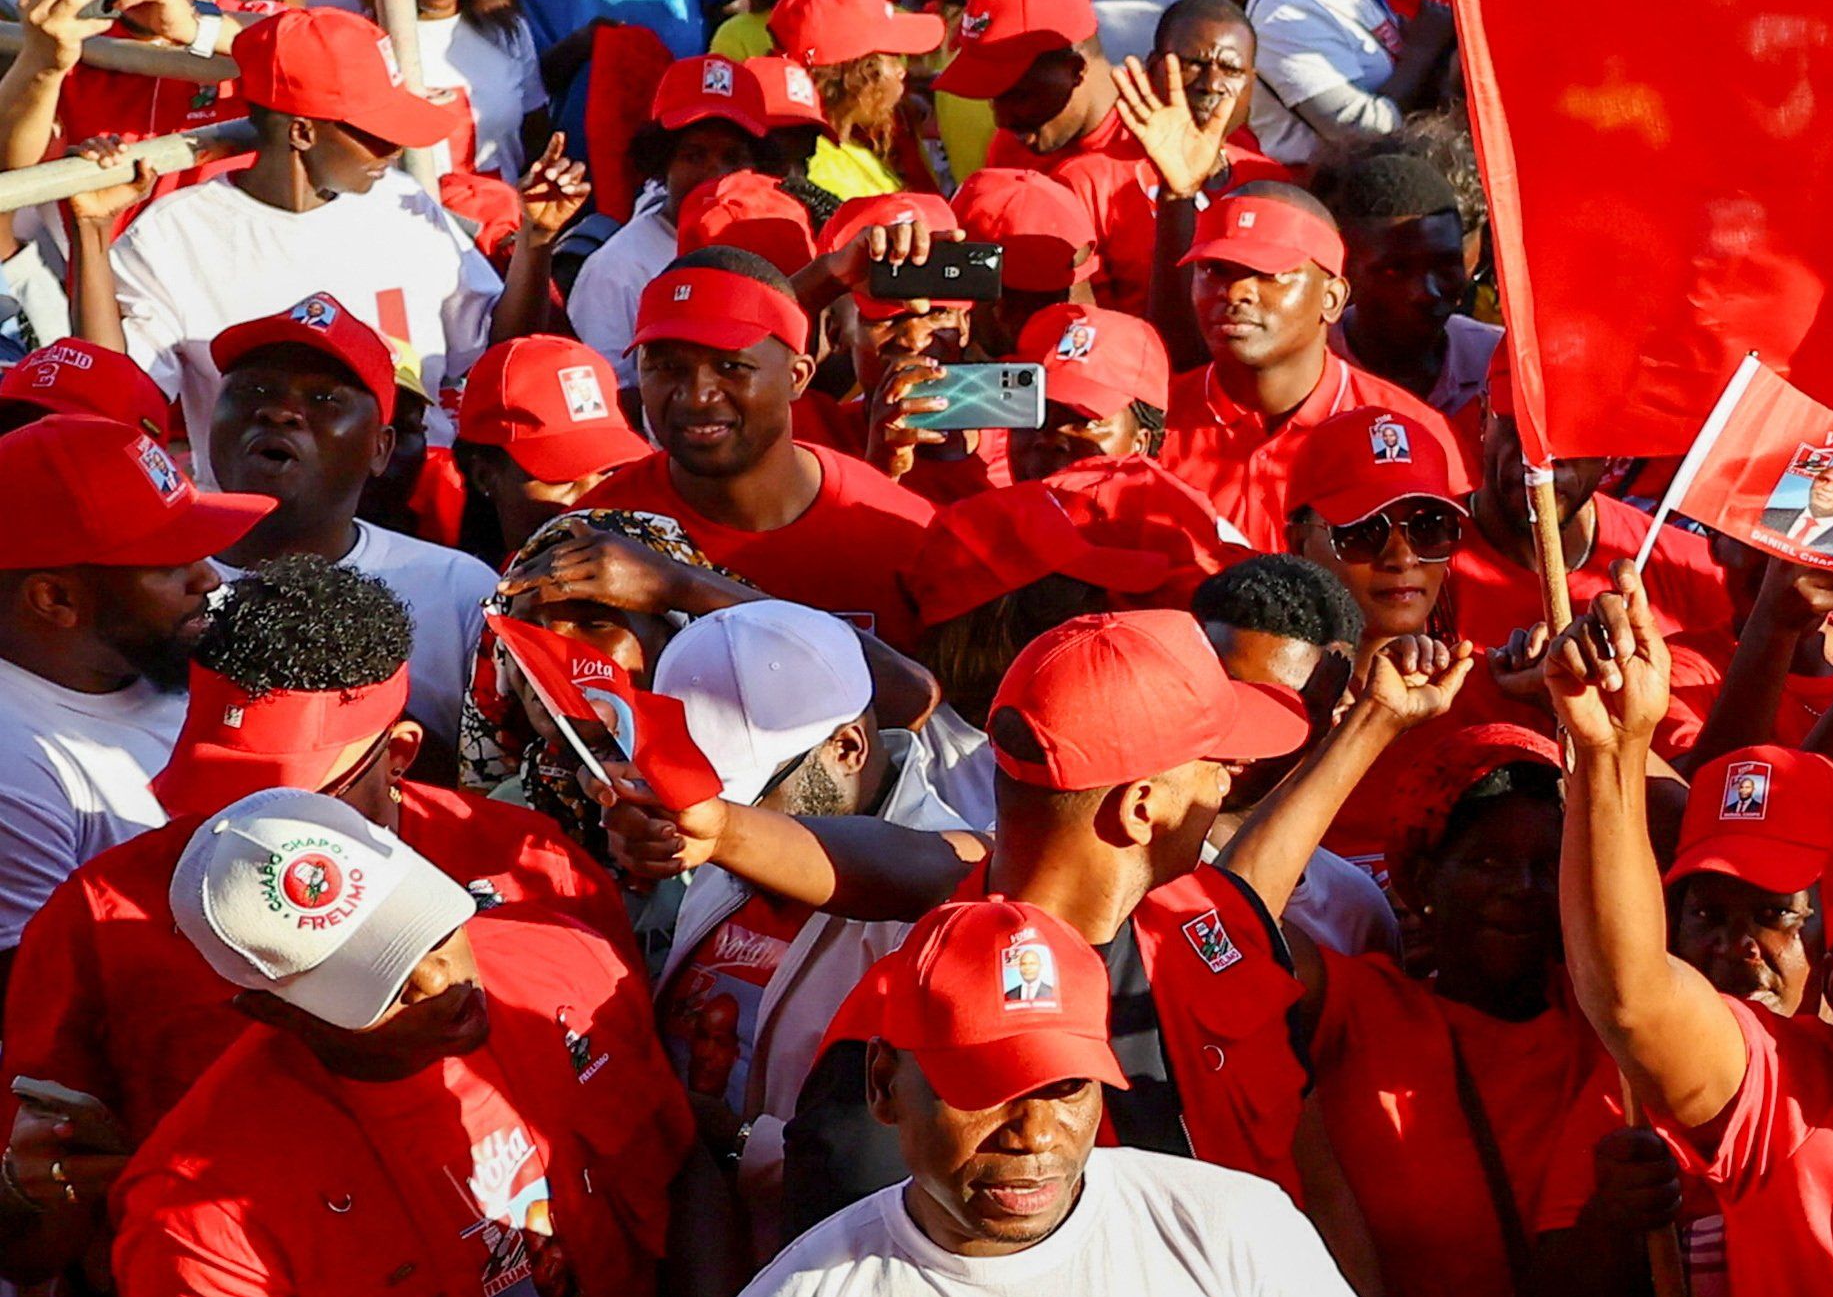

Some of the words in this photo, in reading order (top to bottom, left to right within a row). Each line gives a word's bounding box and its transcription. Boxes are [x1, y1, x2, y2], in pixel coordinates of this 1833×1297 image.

[1750, 530, 1796, 557] DANIEL
[572, 657, 614, 678] Vota
[281, 837, 343, 854] CHAPO
[260, 853, 283, 913] CHAPO
[297, 867, 365, 931] FRELIMO
